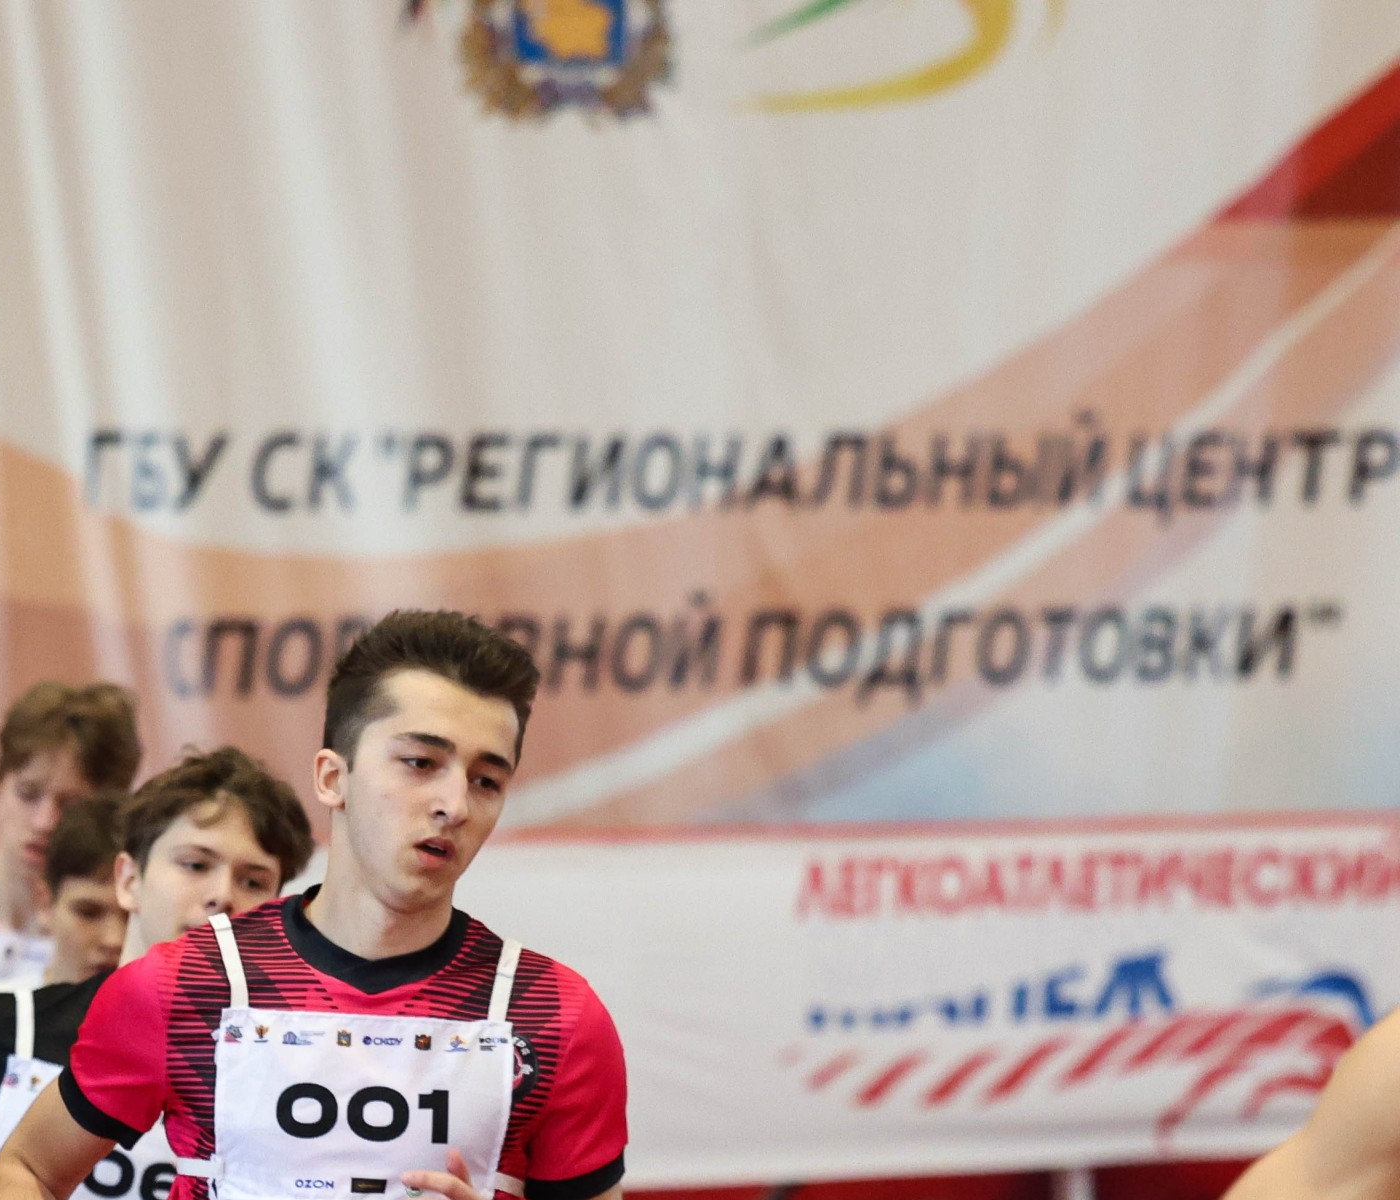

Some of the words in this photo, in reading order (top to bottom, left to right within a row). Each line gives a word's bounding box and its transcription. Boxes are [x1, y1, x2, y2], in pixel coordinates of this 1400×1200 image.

[84, 429, 228, 512] ГБУ
[250, 430, 358, 513] СК
[1124, 426, 1400, 527] ЦЕНТР
[275, 1081, 449, 1144] 001
[294, 1178, 335, 1189] OZON
